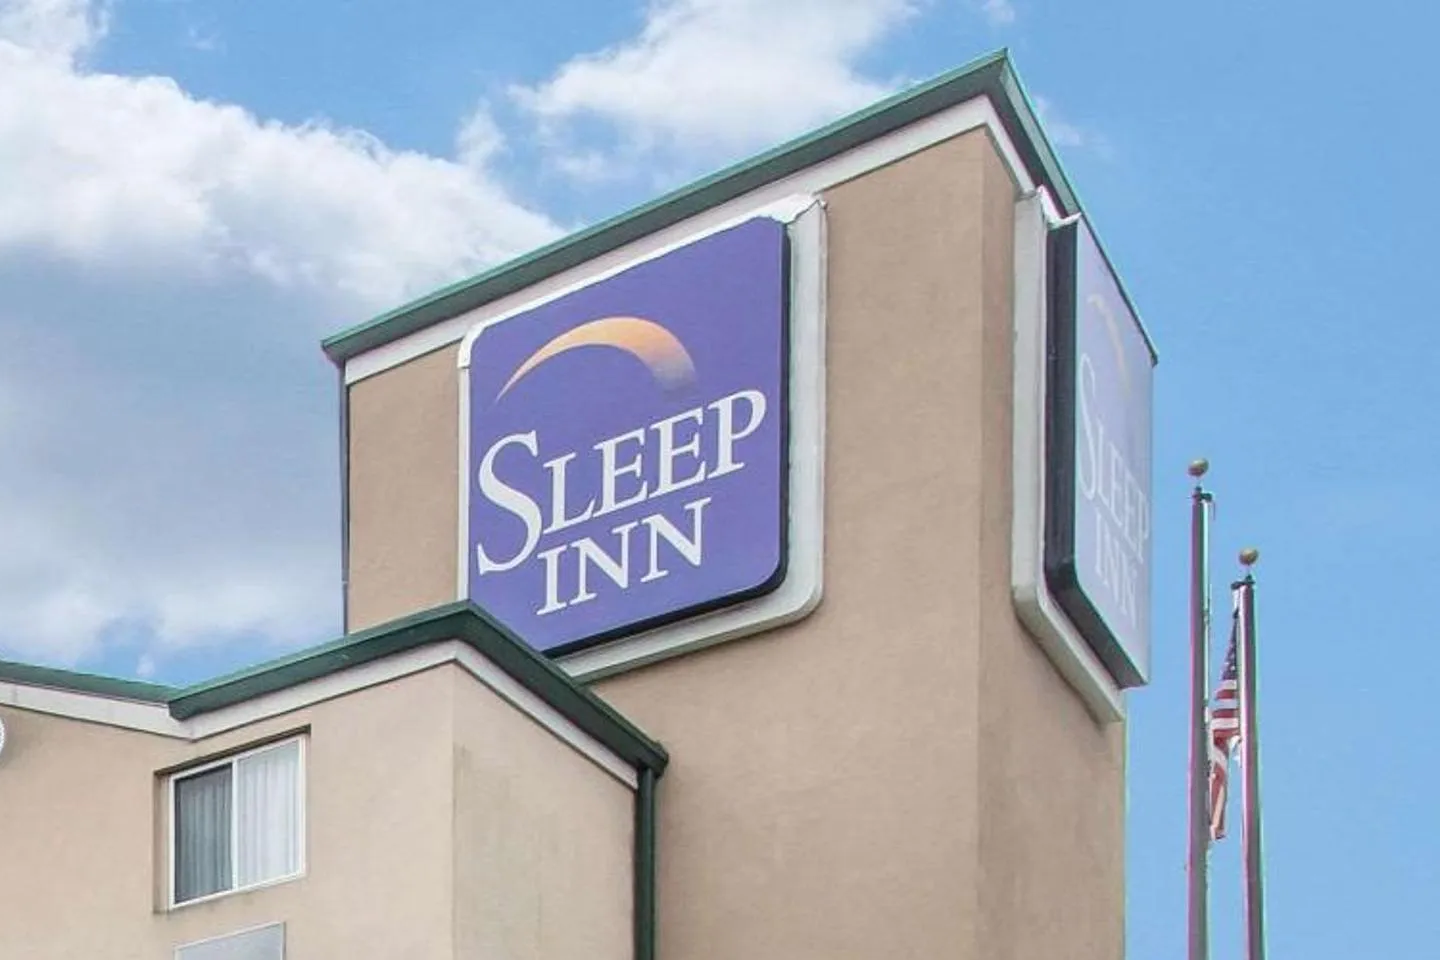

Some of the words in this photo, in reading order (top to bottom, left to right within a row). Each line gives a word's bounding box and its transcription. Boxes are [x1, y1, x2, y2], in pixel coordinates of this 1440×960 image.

[477, 390, 767, 575] SLEEP
[1078, 353, 1149, 562] SLEEP
[536, 497, 711, 615] INN
[1095, 507, 1137, 628] INN
